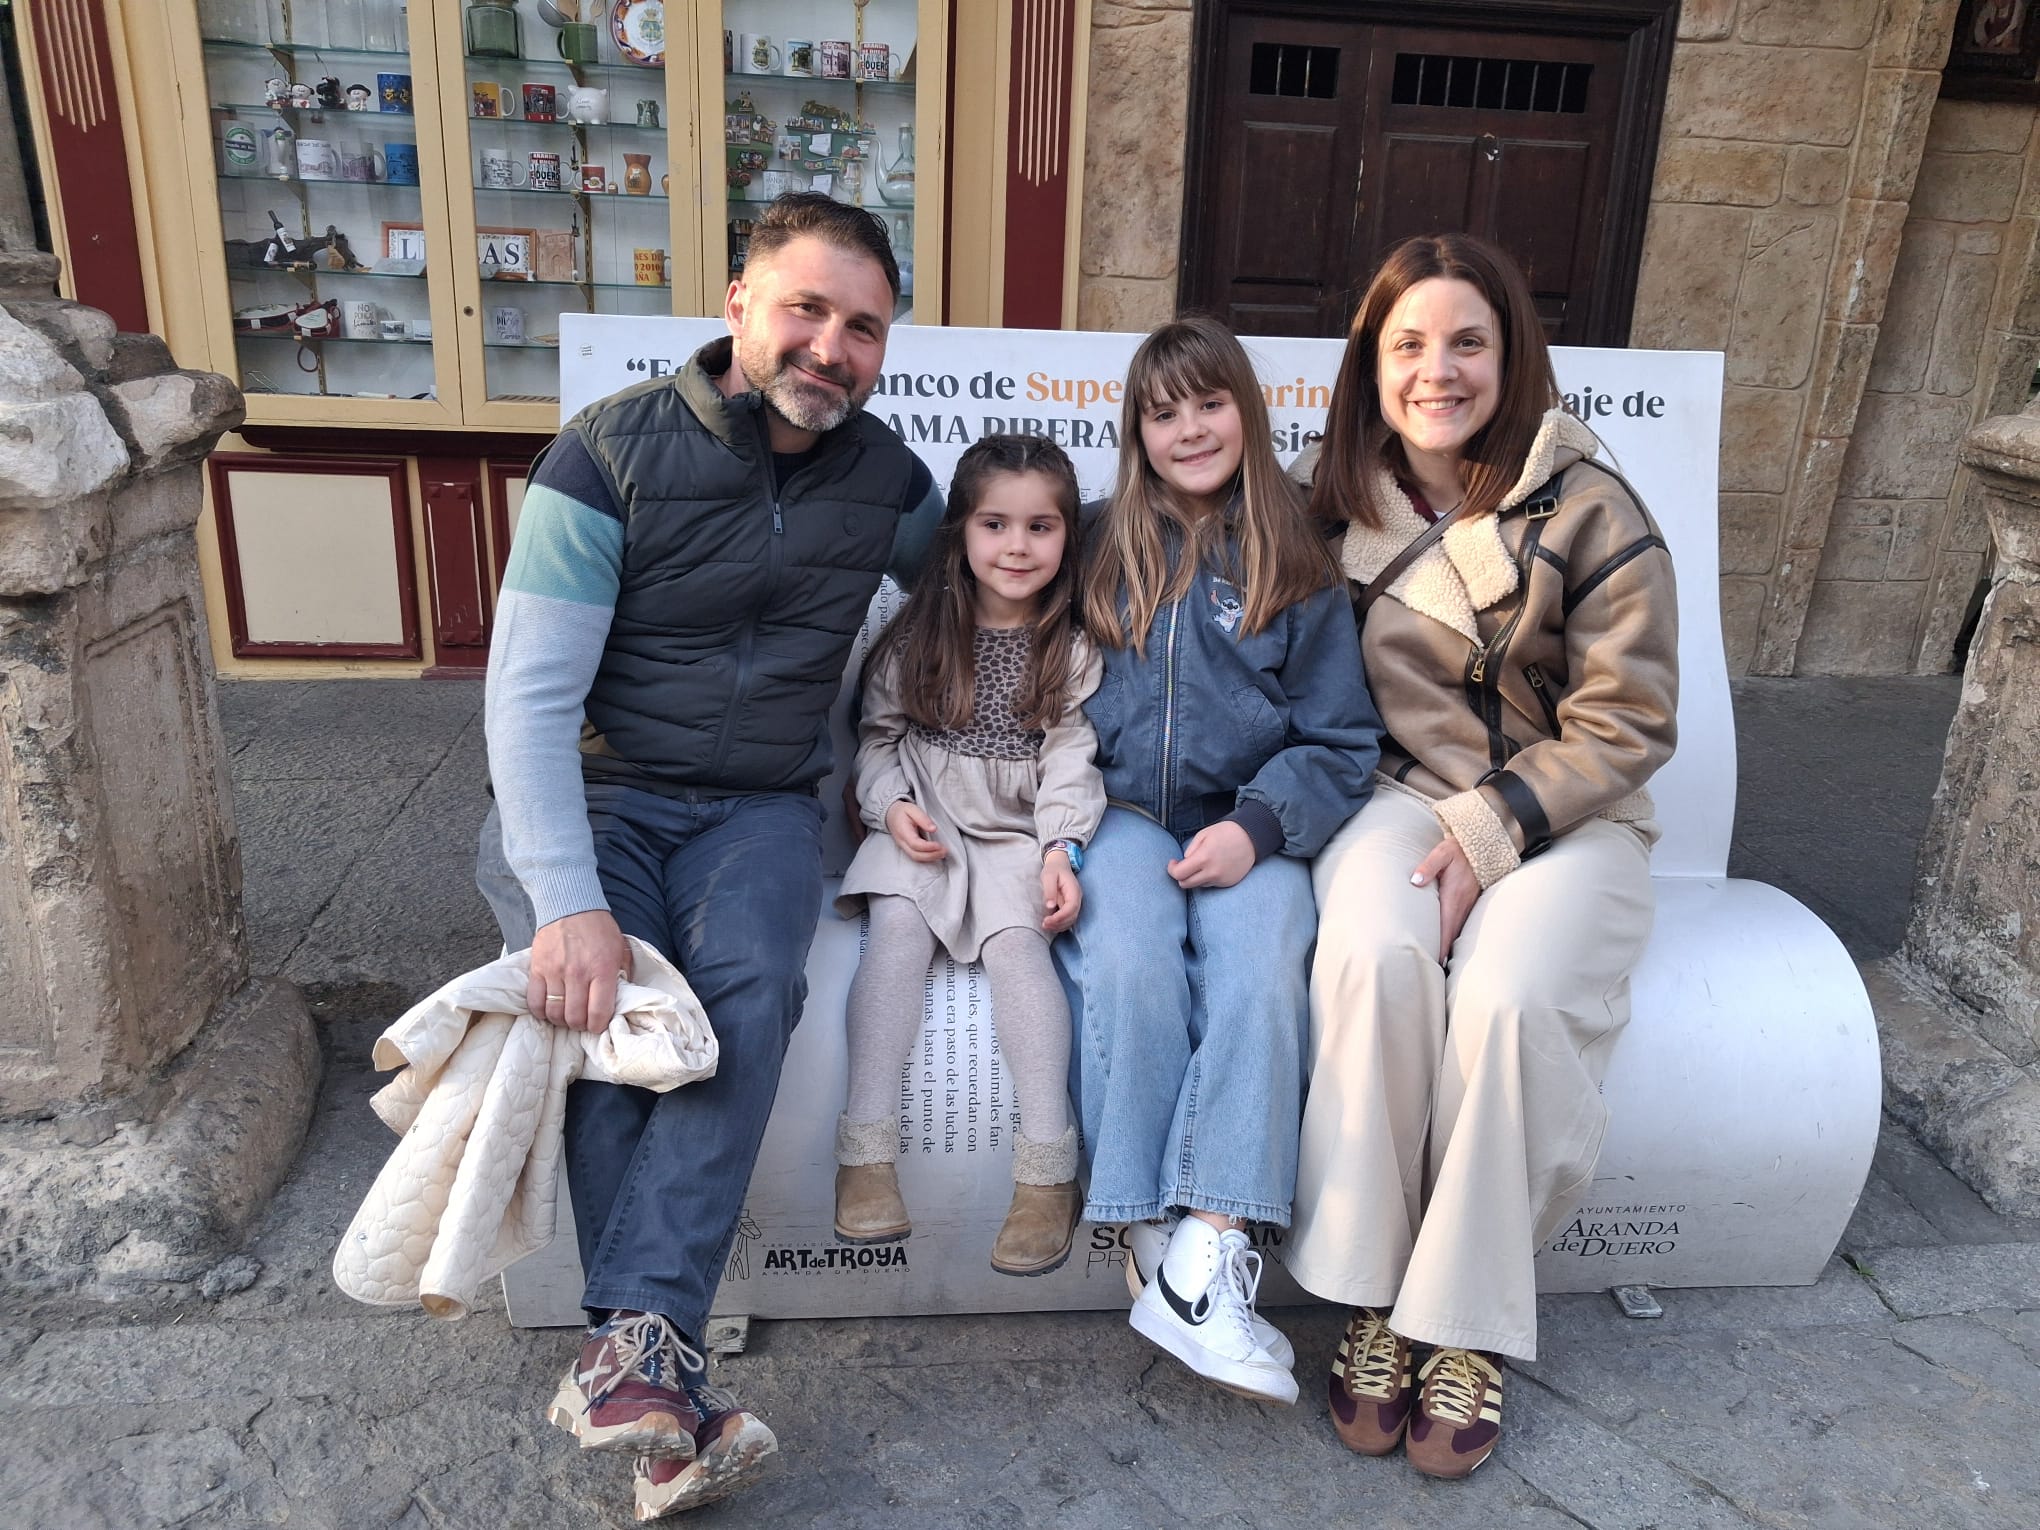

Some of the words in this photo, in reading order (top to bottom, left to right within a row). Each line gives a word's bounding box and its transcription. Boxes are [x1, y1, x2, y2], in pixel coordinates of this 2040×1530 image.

[873, 371, 960, 398] anco
[969, 371, 1016, 400] de
[1026, 371, 1123, 410] Supe
[1561, 386, 1614, 422] aje
[1622, 390, 1665, 418] de
[886, 413, 971, 444] AMA
[877, 606, 889, 630] par
[923, 962, 937, 1024] ulmanas,
[967, 961, 981, 1019] edievales,
[946, 1005, 956, 1024] era
[923, 1029, 937, 1066] hasta
[943, 1028, 957, 1065] pasto
[966, 1022, 978, 1049] que
[900, 1061, 915, 1110] batalla
[923, 1071, 937, 1084] el
[946, 1068, 959, 1085] de
[968, 1054, 981, 1123] recuerdan
[945, 1088, 959, 1107] las
[991, 1059, 1004, 1122] animales
[900, 1115, 914, 1132] de
[920, 1088, 934, 1133] punto
[944, 1110, 958, 1153] luchas
[967, 1127, 978, 1152] con
[989, 1126, 1001, 1153] fan-
[900, 1136, 914, 1155] las
[922, 1137, 936, 1154] de
[1576, 1204, 1687, 1215] AYUNTAMIENTO
[1560, 1218, 1681, 1238] ARANDA
[1087, 1250, 1128, 1269] PR
